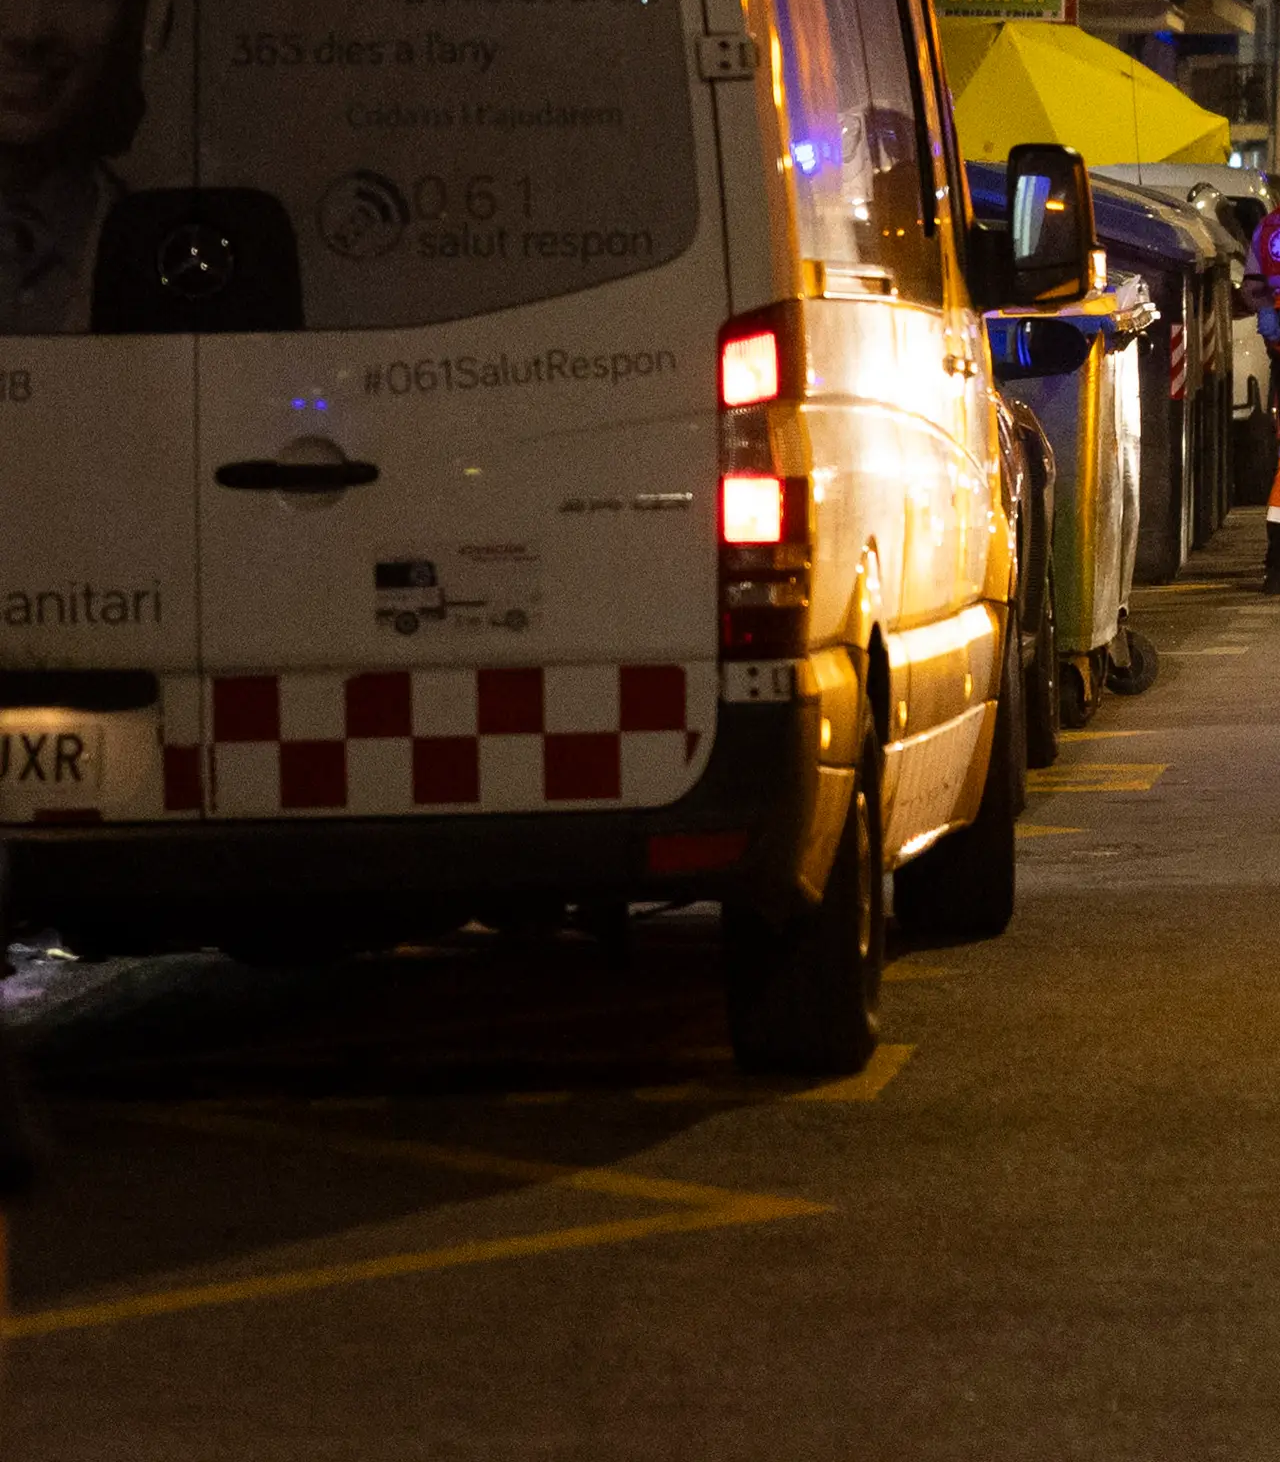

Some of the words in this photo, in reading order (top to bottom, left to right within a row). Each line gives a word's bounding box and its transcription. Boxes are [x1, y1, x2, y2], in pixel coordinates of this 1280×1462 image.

[314, 31, 384, 66] dies
[394, 38, 415, 66] a
[419, 226, 512, 260] salut
[523, 228, 655, 264] respon
[364, 348, 678, 396] #061SalutRespon
[5, 579, 163, 626] anitari
